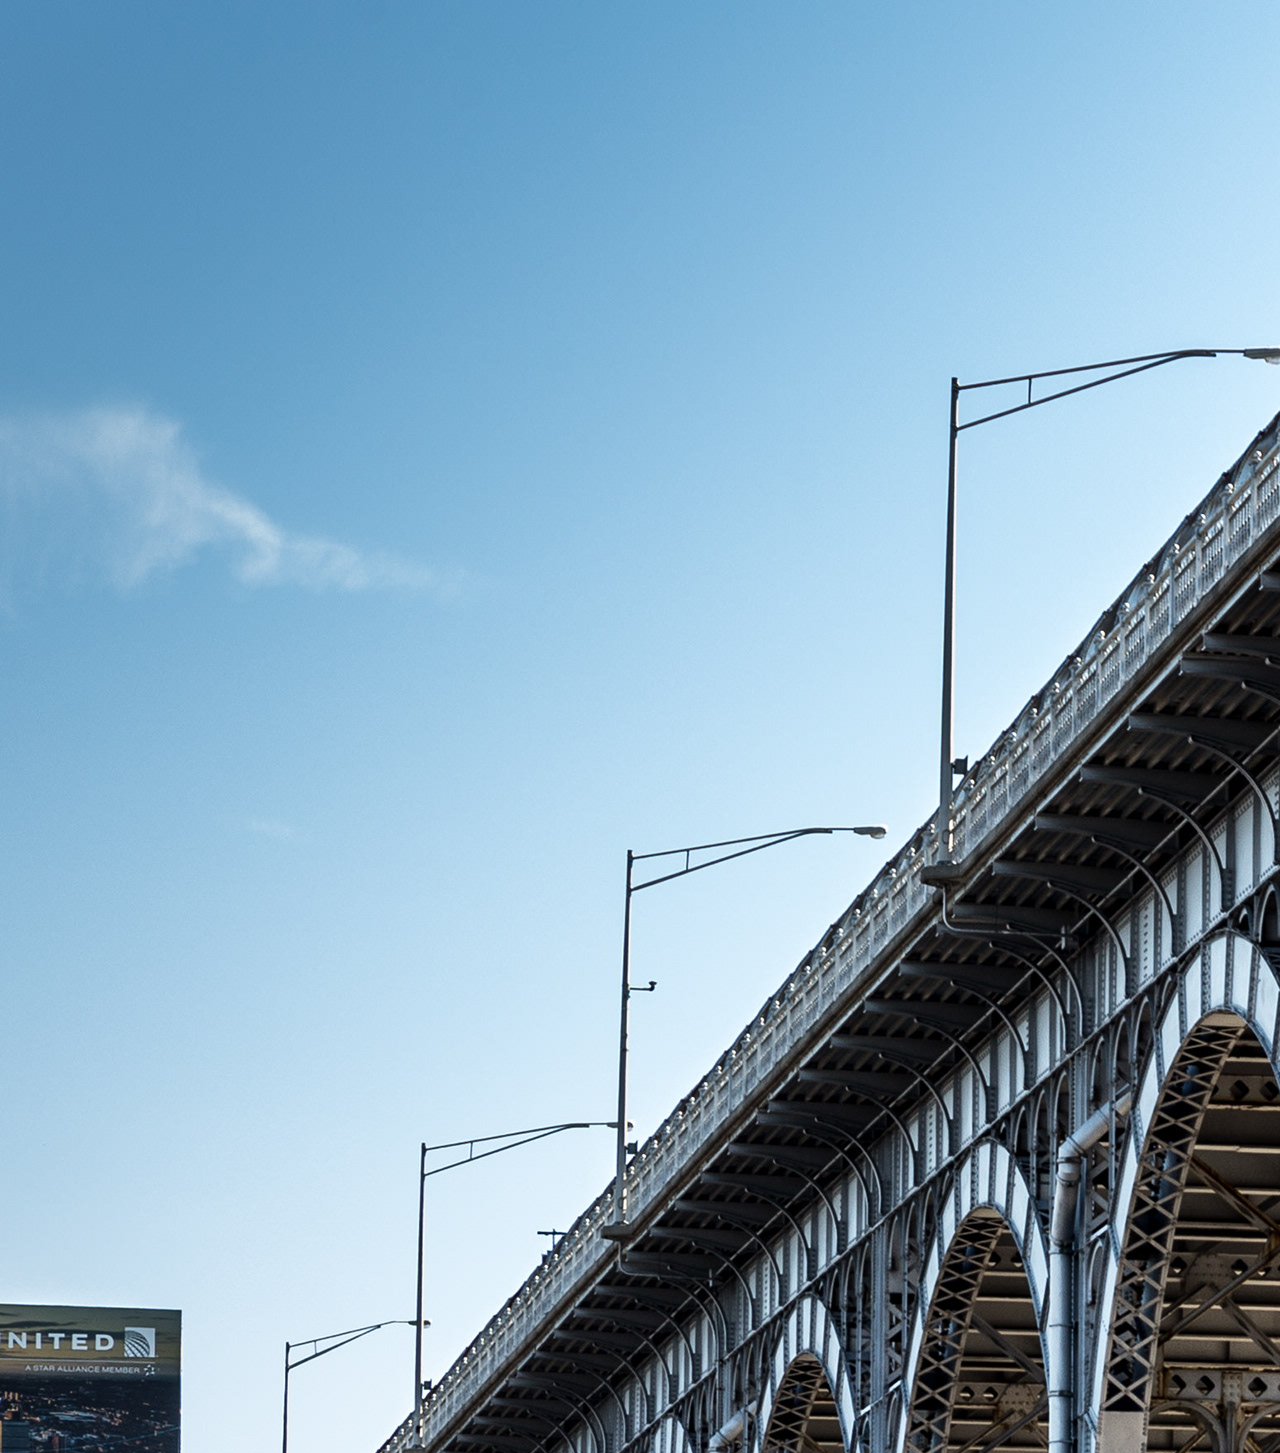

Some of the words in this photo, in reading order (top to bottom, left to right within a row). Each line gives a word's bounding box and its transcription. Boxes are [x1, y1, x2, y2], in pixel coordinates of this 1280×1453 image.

[0, 1331, 115, 1350] NITED
[57, 1365, 100, 1373] ALLIANCE
[101, 1365, 141, 1374] MEMBER
